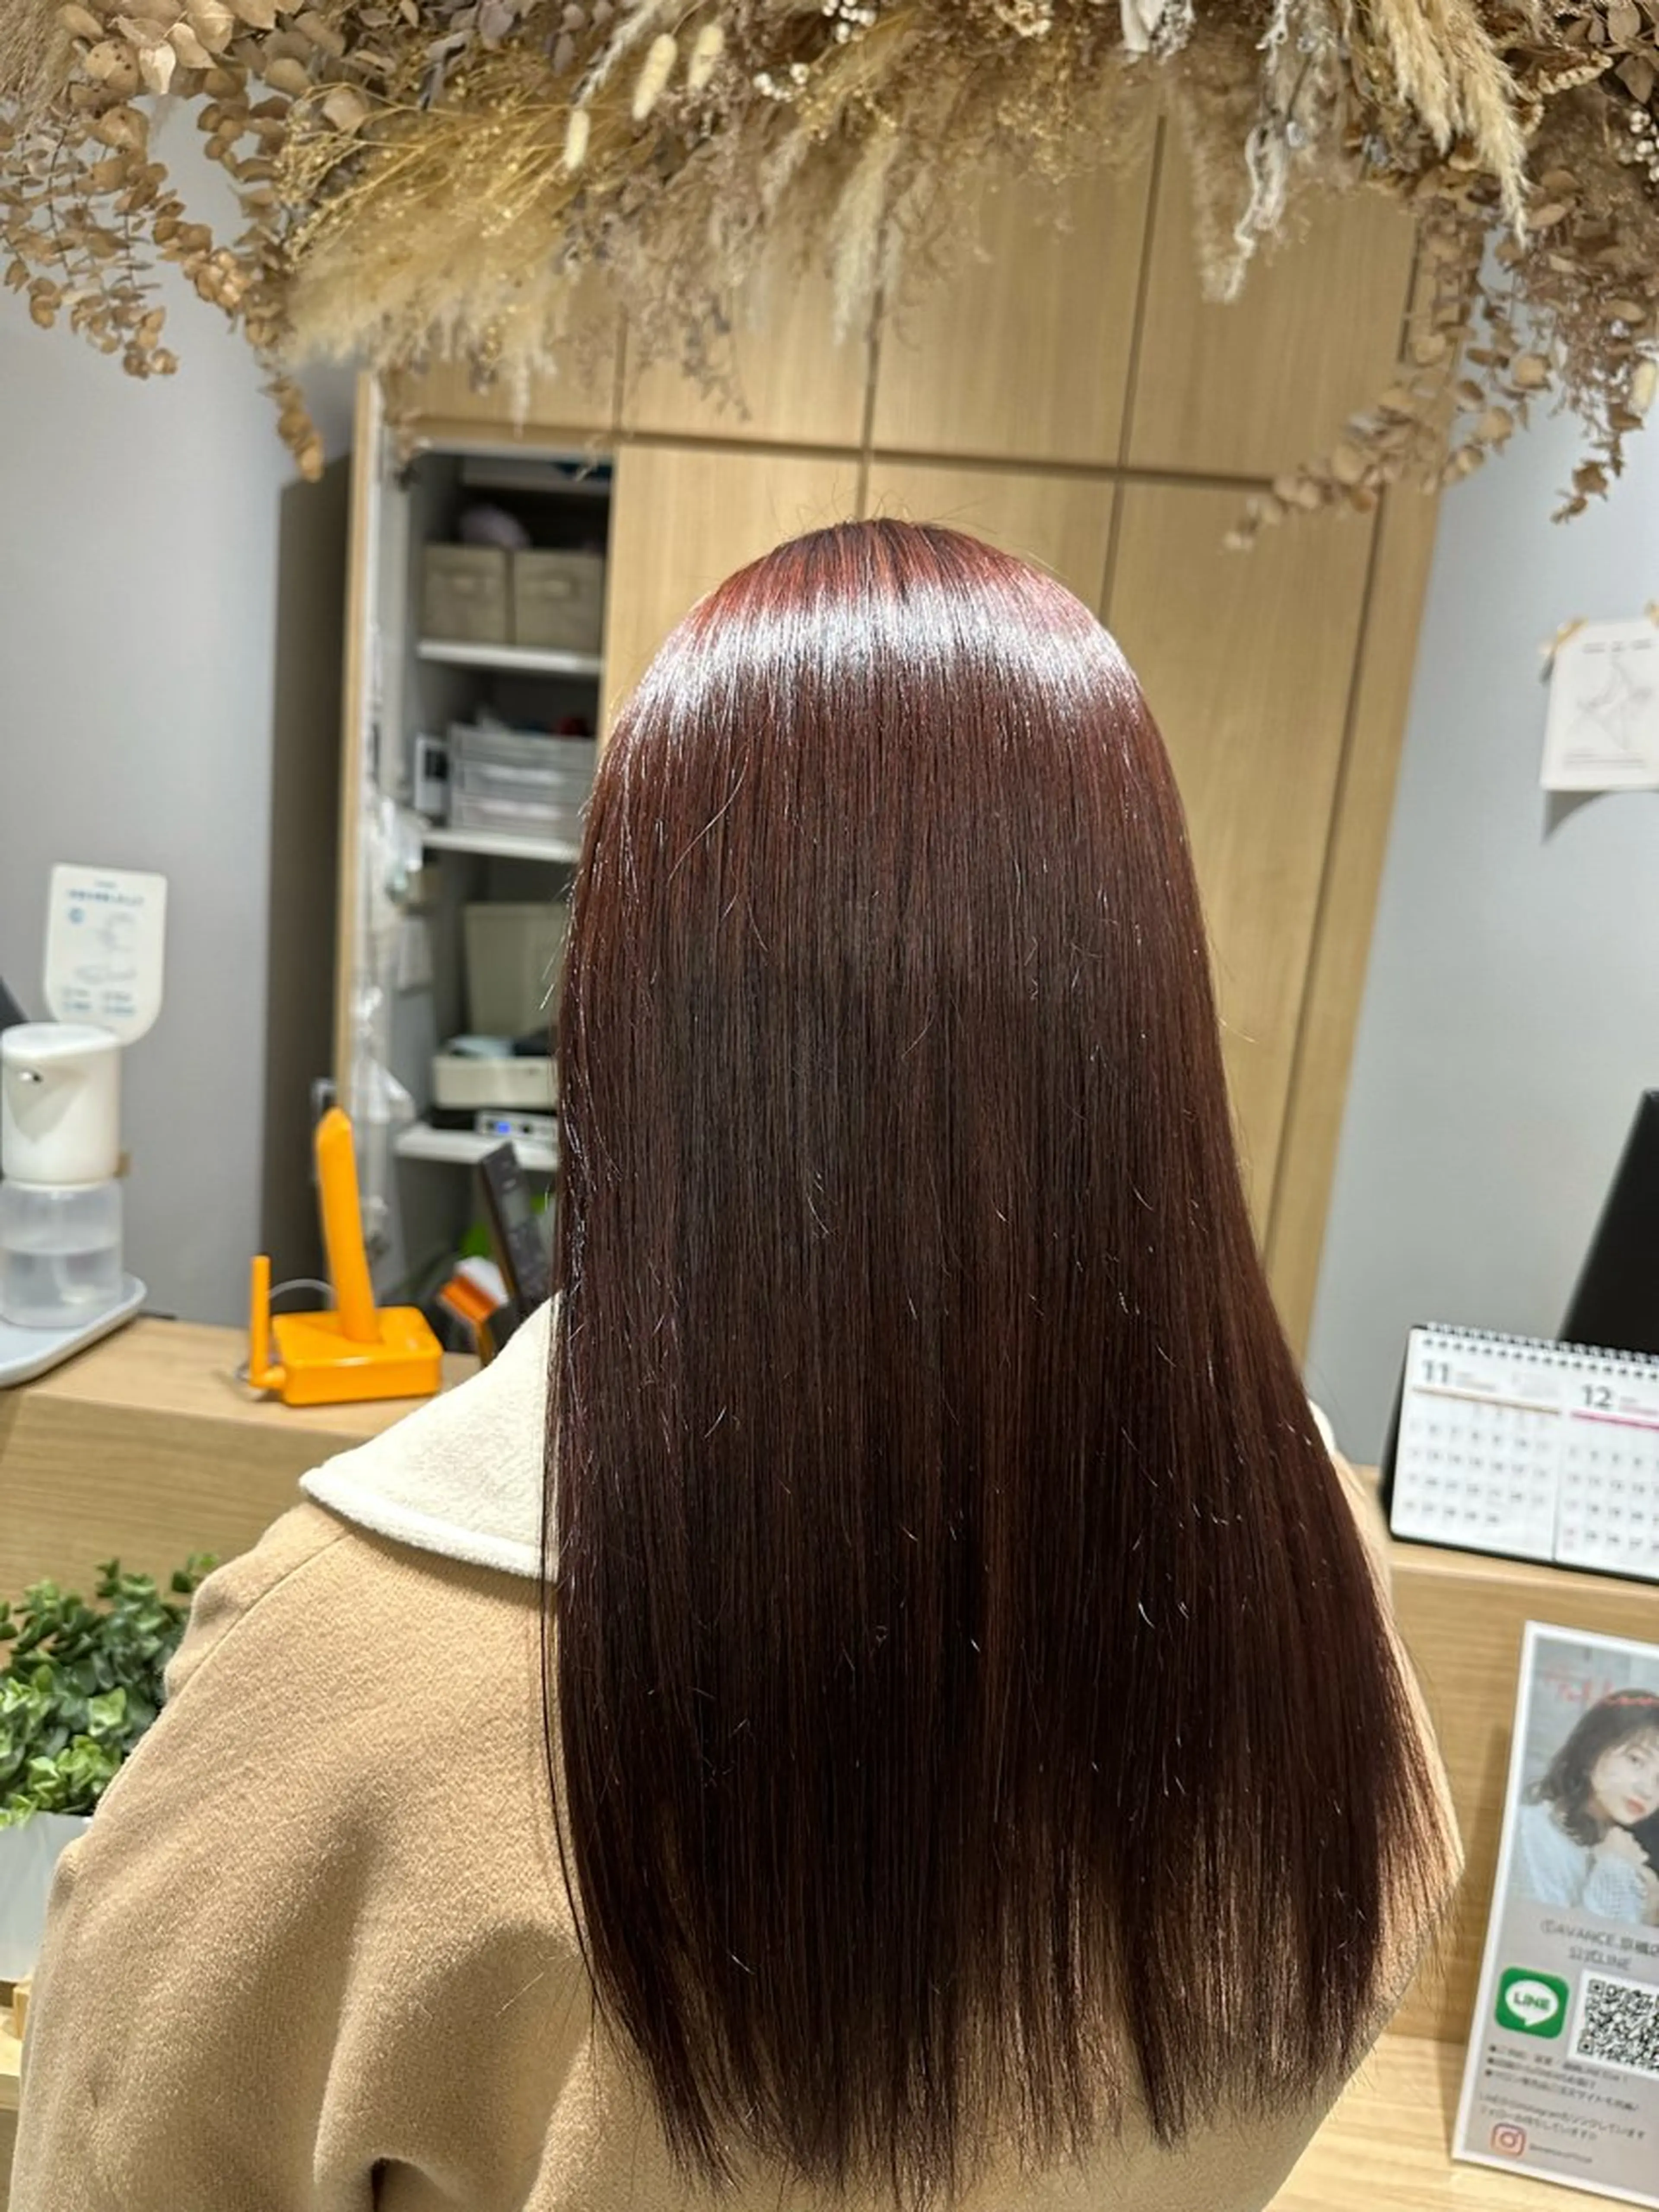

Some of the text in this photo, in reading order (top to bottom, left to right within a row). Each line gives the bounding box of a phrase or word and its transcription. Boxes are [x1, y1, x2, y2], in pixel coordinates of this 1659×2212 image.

[1424, 1359, 1449, 1384] 11
[1583, 1384, 1612, 1407] 12
[1513, 1990, 1551, 2011] LINE
